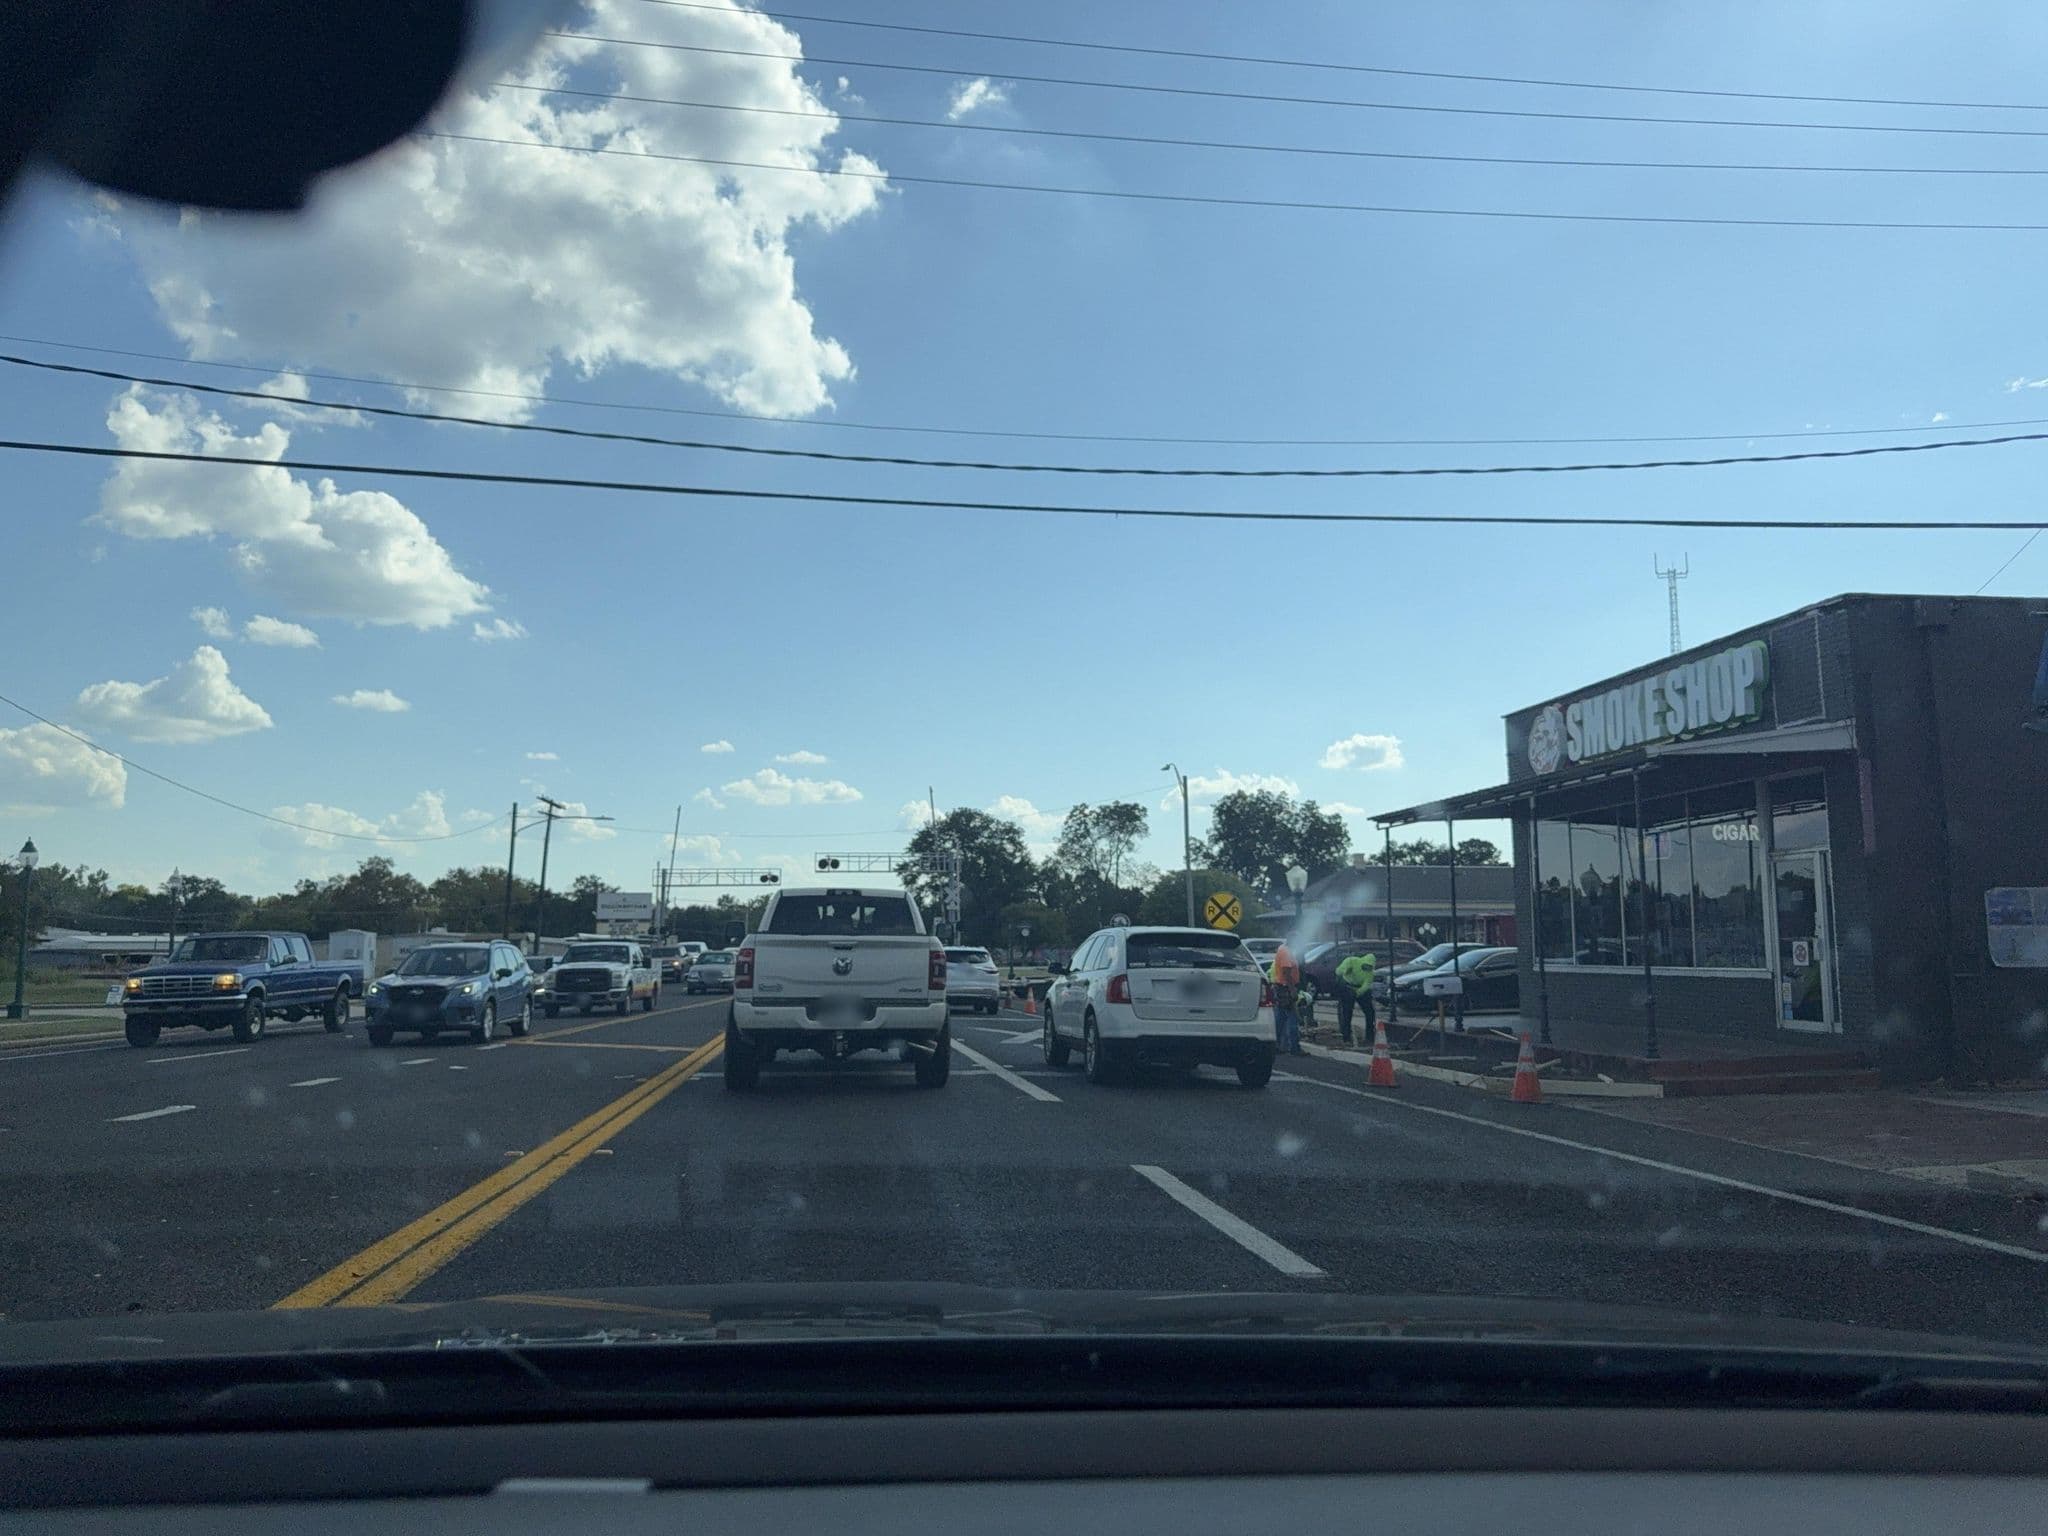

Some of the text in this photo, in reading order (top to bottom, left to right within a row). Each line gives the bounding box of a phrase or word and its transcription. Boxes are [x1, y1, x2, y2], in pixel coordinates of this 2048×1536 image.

[1566, 645, 1762, 761] SMOKE SHOP
[1712, 824, 1760, 841] CIGAR
[1208, 906, 1240, 916] R R
